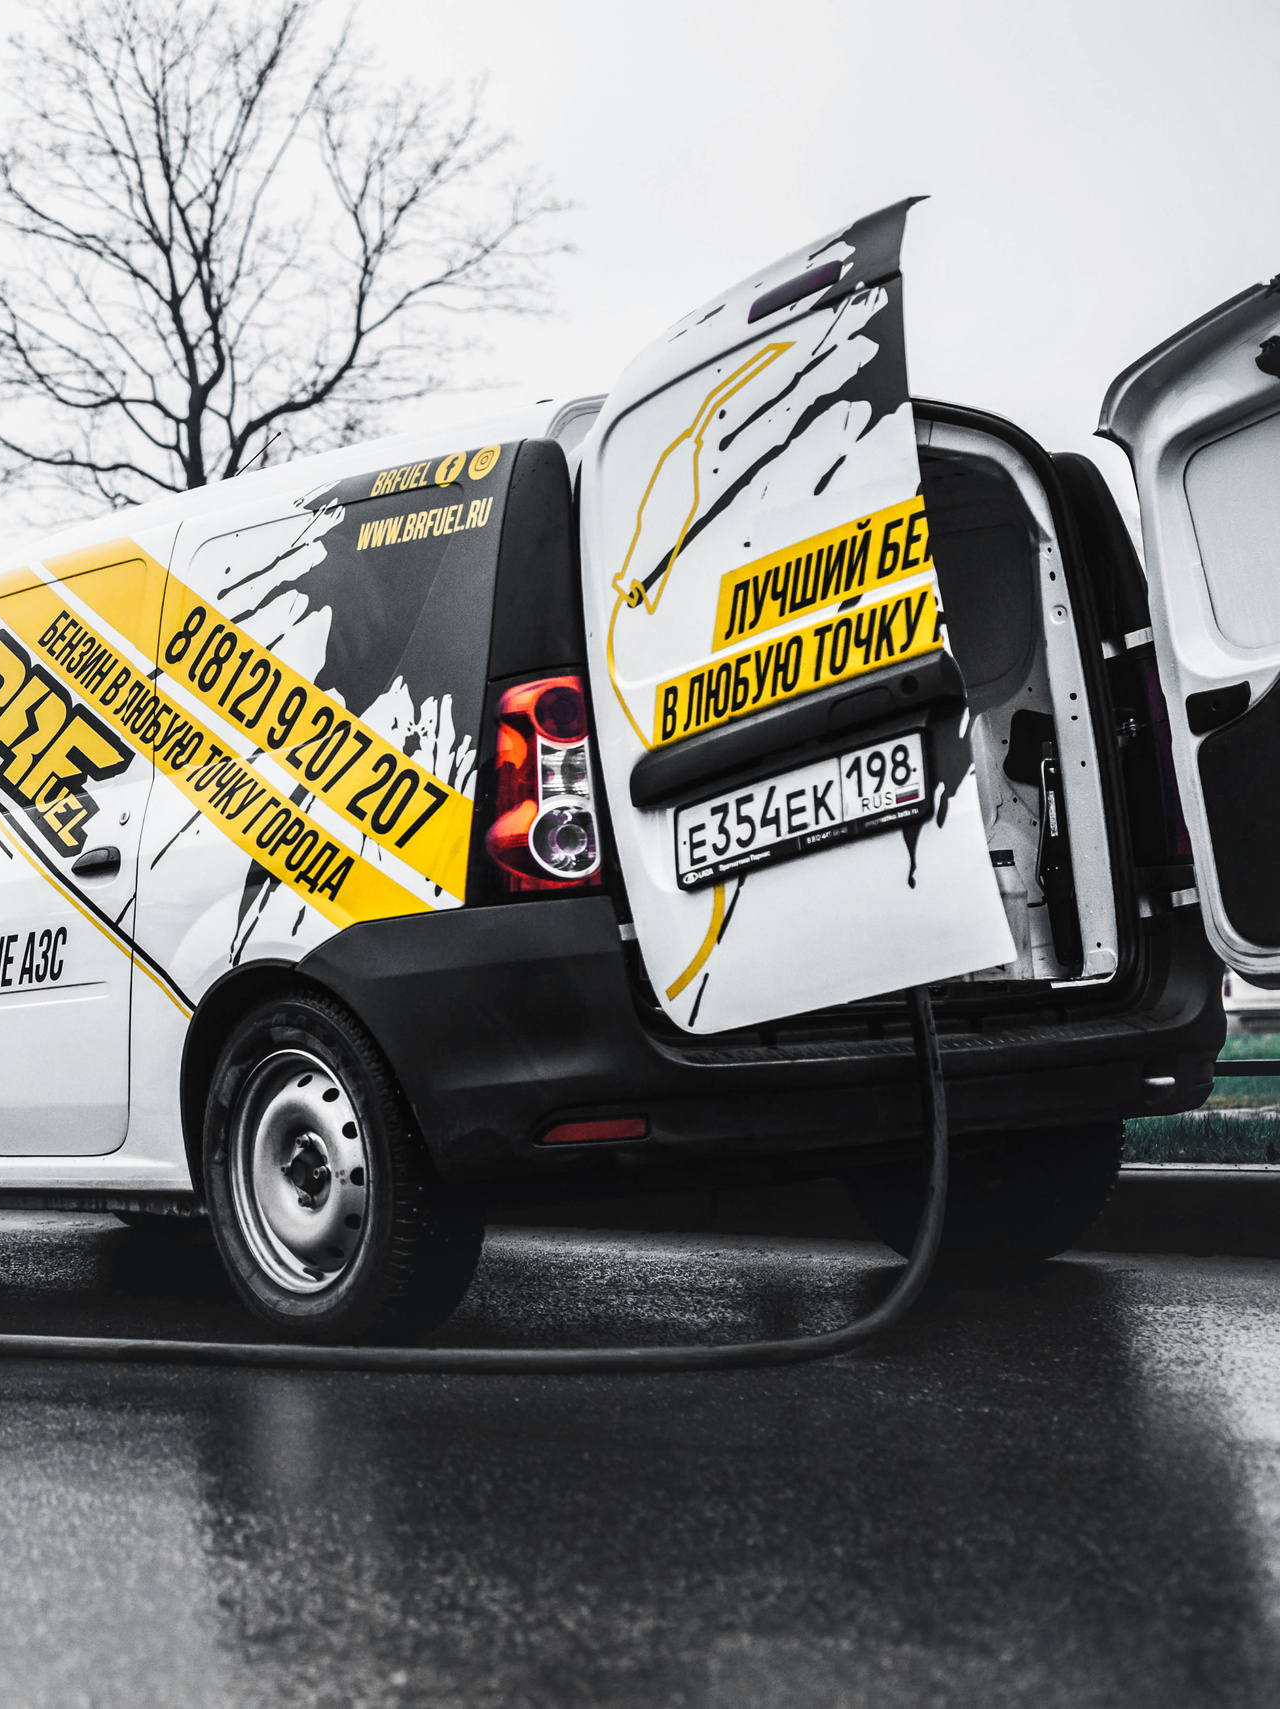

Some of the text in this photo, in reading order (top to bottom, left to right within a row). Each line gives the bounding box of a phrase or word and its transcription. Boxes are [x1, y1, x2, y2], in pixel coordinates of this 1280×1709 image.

[356, 496, 494, 551] WWW.BRFUEL.RU
[370, 461, 432, 497] BRFUEL
[724, 509, 933, 641] ЛУЧШИЙ БЕ
[165, 606, 449, 849] 8 (812) 9 207 207
[660, 685, 678, 742] В
[683, 634, 804, 732] ЛЮБУЮ
[813, 590, 929, 682] ТОЧКУ
[37, 610, 356, 902] БЕНЗИН В ЛЮБУЮ ТОЧКУ ГОРОДА
[689, 744, 912, 867] Е354ЕК 198
[861, 791, 894, 812] RUS
[18, 926, 68, 985] АЗС
